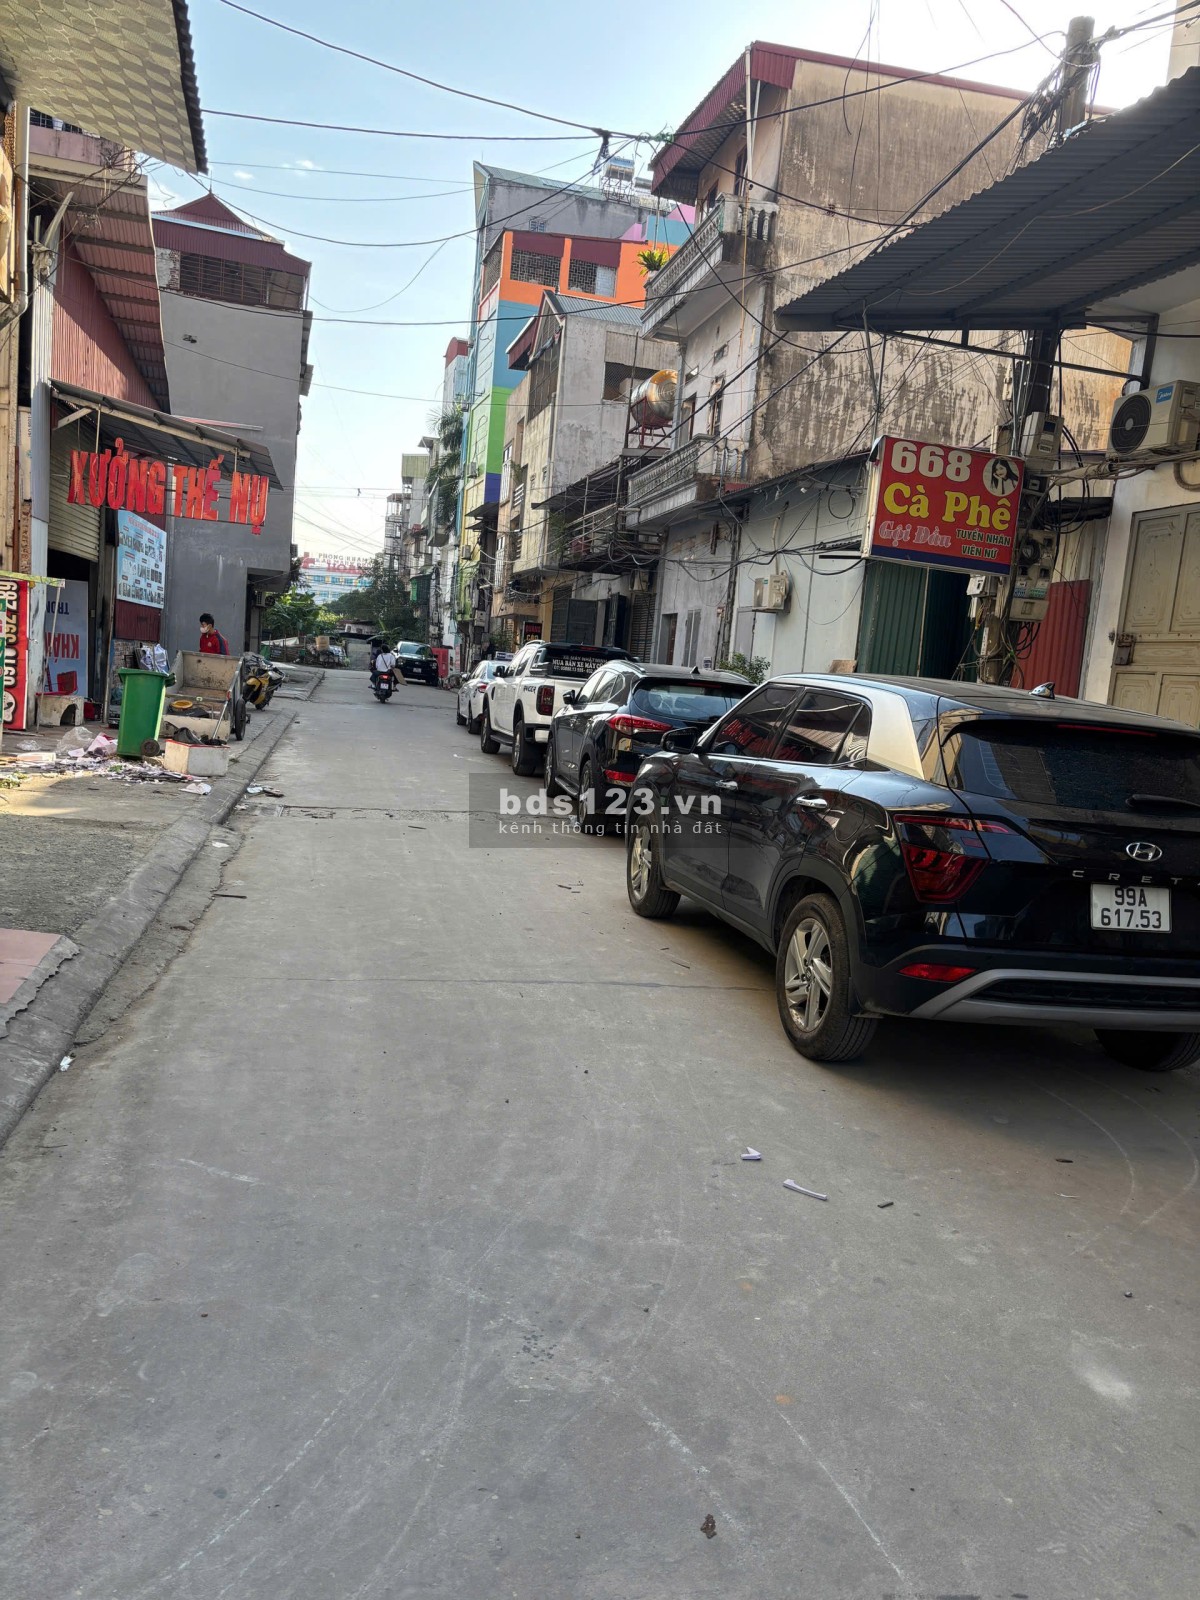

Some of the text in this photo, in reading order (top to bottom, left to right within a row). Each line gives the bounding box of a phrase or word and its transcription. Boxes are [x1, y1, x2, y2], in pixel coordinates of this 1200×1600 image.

[891, 441, 972, 482] 668
[67, 437, 166, 515] XƯỞNG
[173, 454, 225, 521] THẾ
[883, 482, 1011, 531] Cà Phê
[879, 520, 912, 547] Gội
[985, 533, 1011, 547] NHÂN
[962, 544, 982, 557] VIÊN
[1072, 870, 1200, 886] CRET
[1114, 887, 1148, 907] 99A
[1100, 907, 1162, 929] 617.53
